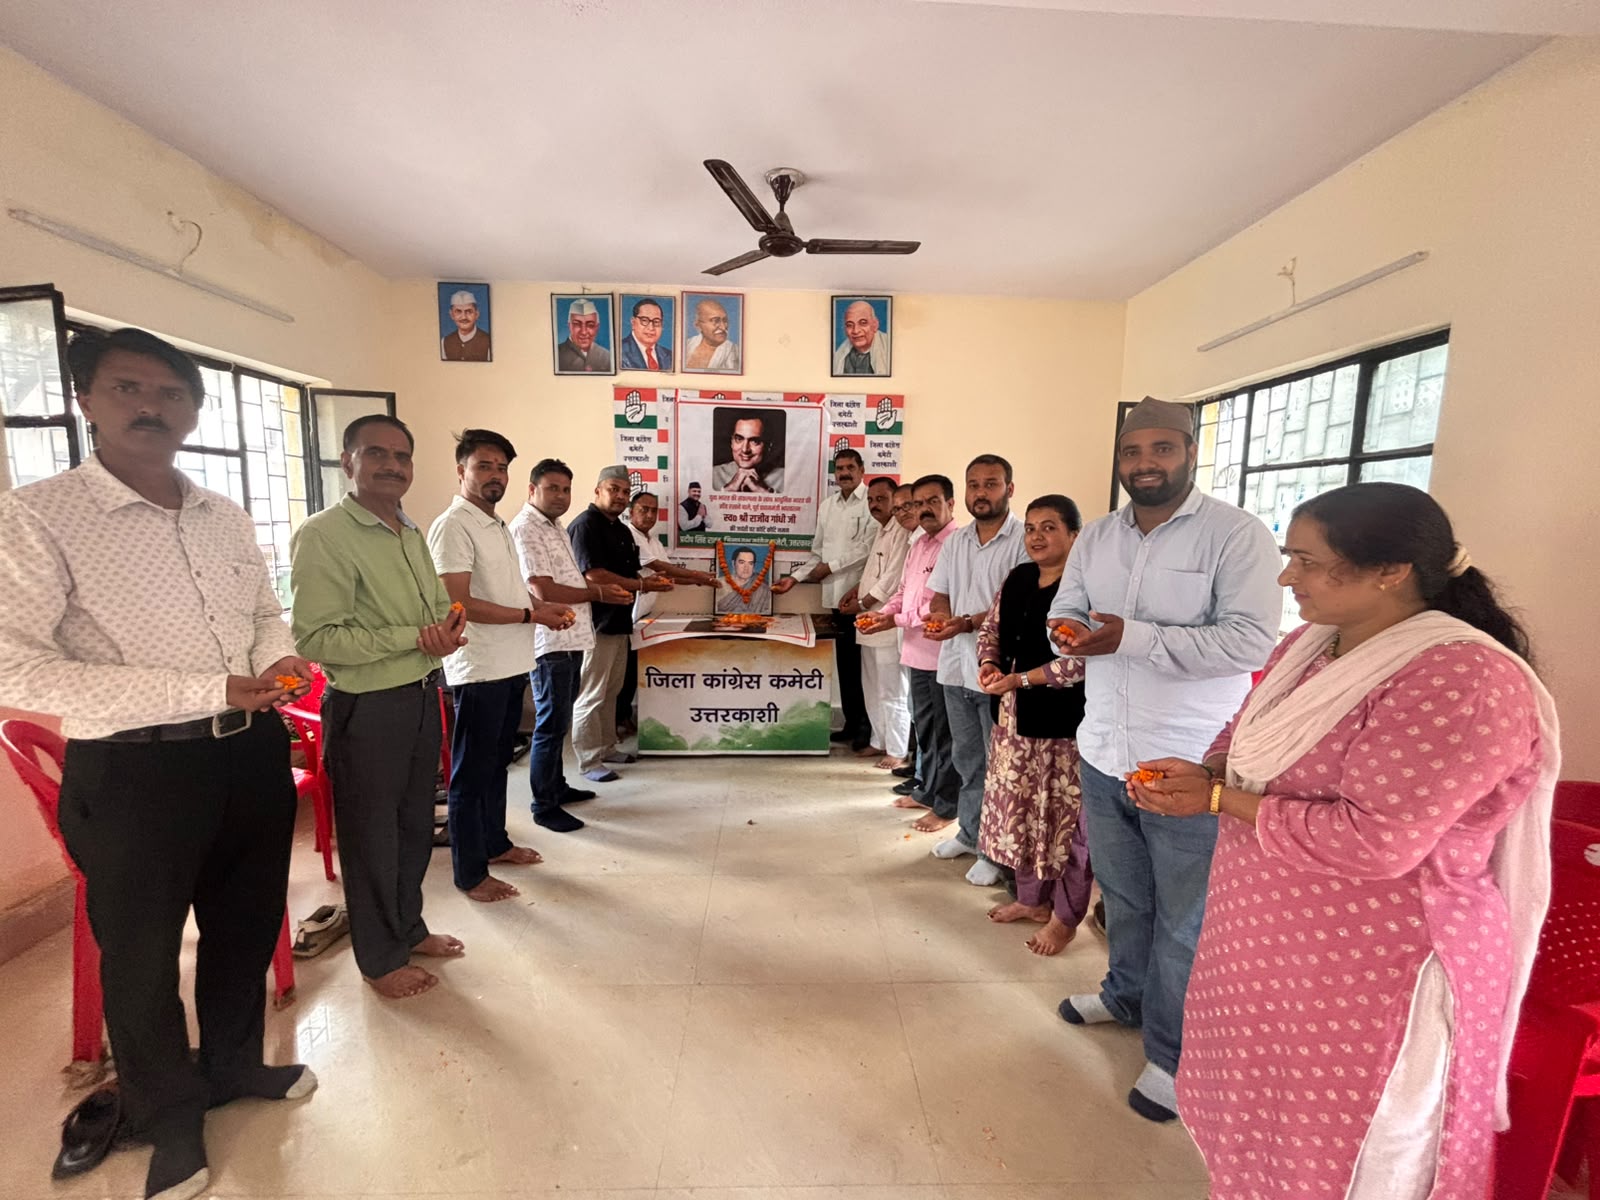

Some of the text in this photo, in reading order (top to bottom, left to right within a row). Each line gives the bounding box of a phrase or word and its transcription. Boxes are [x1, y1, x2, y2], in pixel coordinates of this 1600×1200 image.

[830, 400, 861, 409] जिला कांग्रेस
[838, 410, 853, 418] कमेटी
[832, 420, 858, 428] उत्तरकाशी
[620, 434, 634, 442] जिला
[870, 440, 900, 449] जिला कांग्रेस
[877, 450, 892, 458] कमेटी
[871, 460, 897, 468] उत्तरकाशी
[739, 512, 748, 523] श्री
[750, 512, 769, 523] राजीव
[771, 513, 786, 524] गांधी
[787, 513, 797, 524] जी
[645, 666, 824, 690] जिला कांग्रेस कमेटी
[689, 701, 780, 723] उत्तरकाशी
